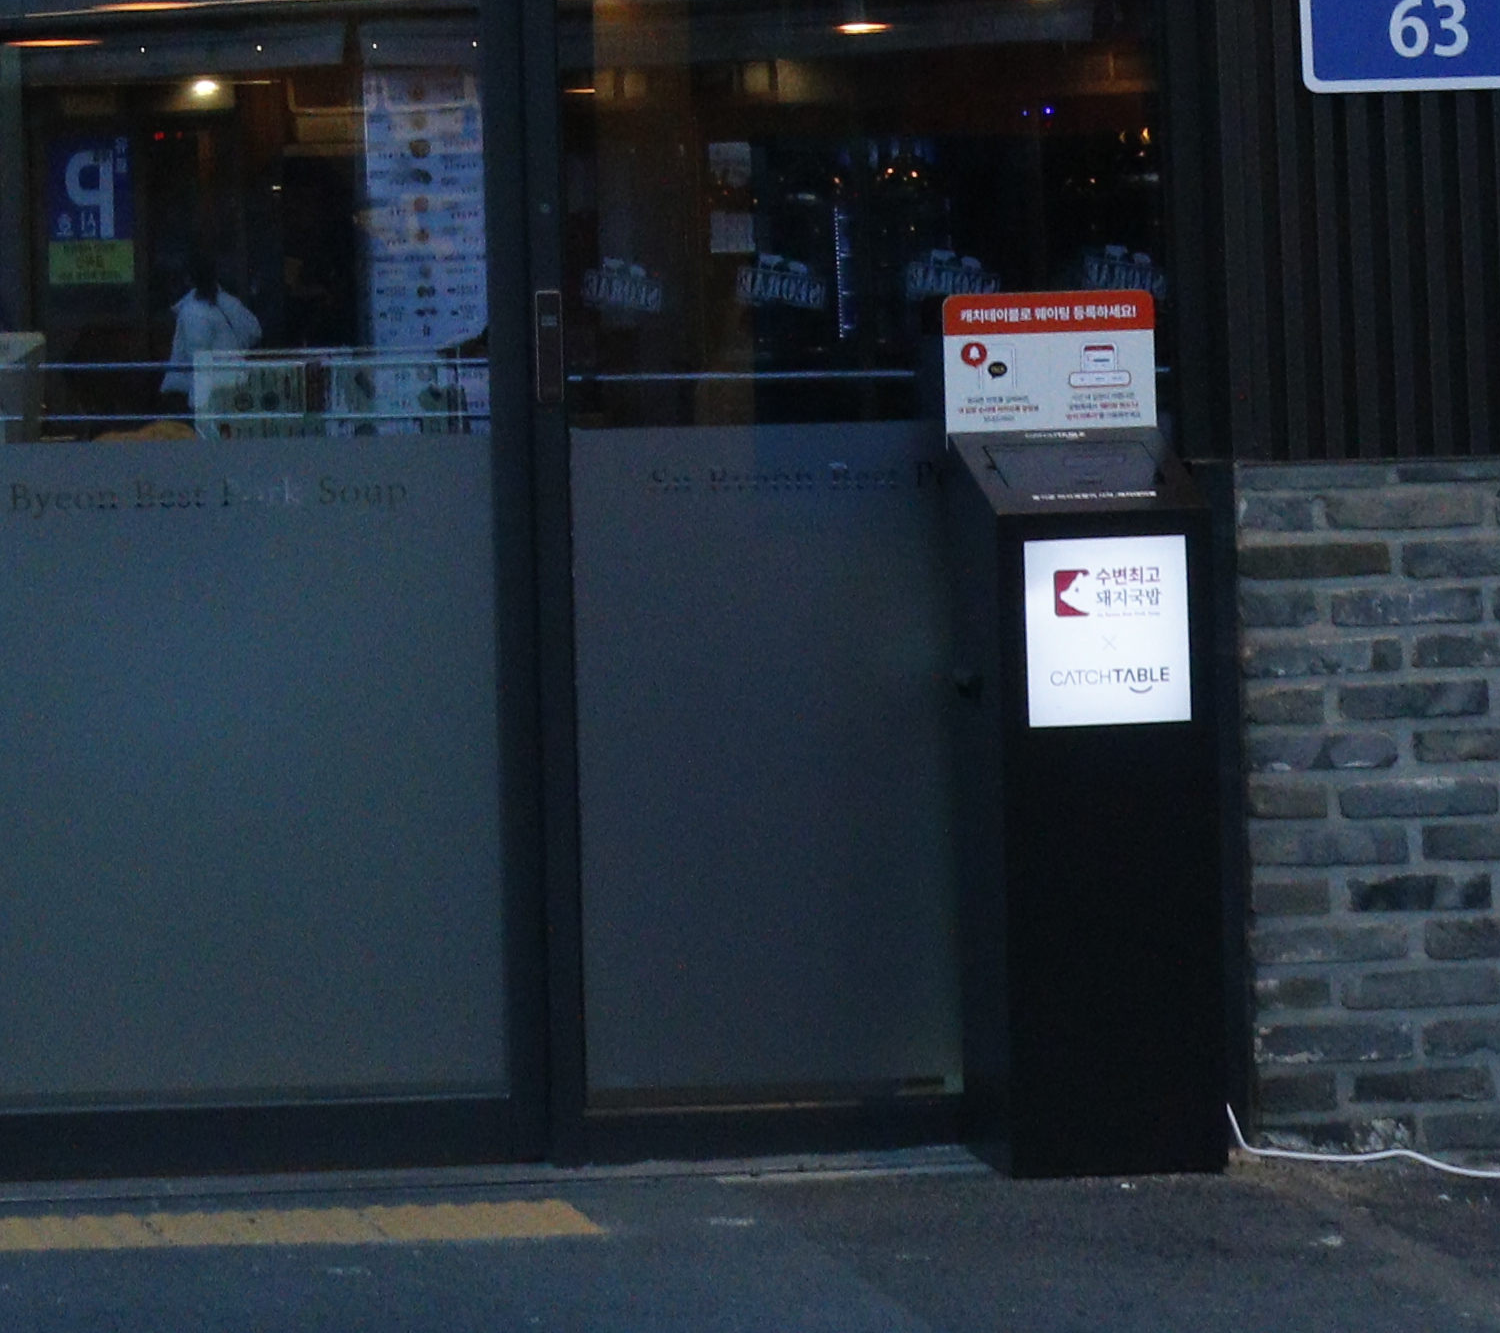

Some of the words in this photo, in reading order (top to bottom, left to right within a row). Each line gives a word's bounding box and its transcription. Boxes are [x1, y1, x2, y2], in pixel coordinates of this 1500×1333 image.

[960, 308, 1032, 324] 캐치테이블로
[1034, 306, 1070, 321] 웨이팅
[1073, 304, 1137, 321] 등록하세요!
[1096, 566, 1161, 586] 수변최고
[1096, 587, 1162, 608] 돼지국밥
[1050, 666, 1171, 688] CATCHTABLE
